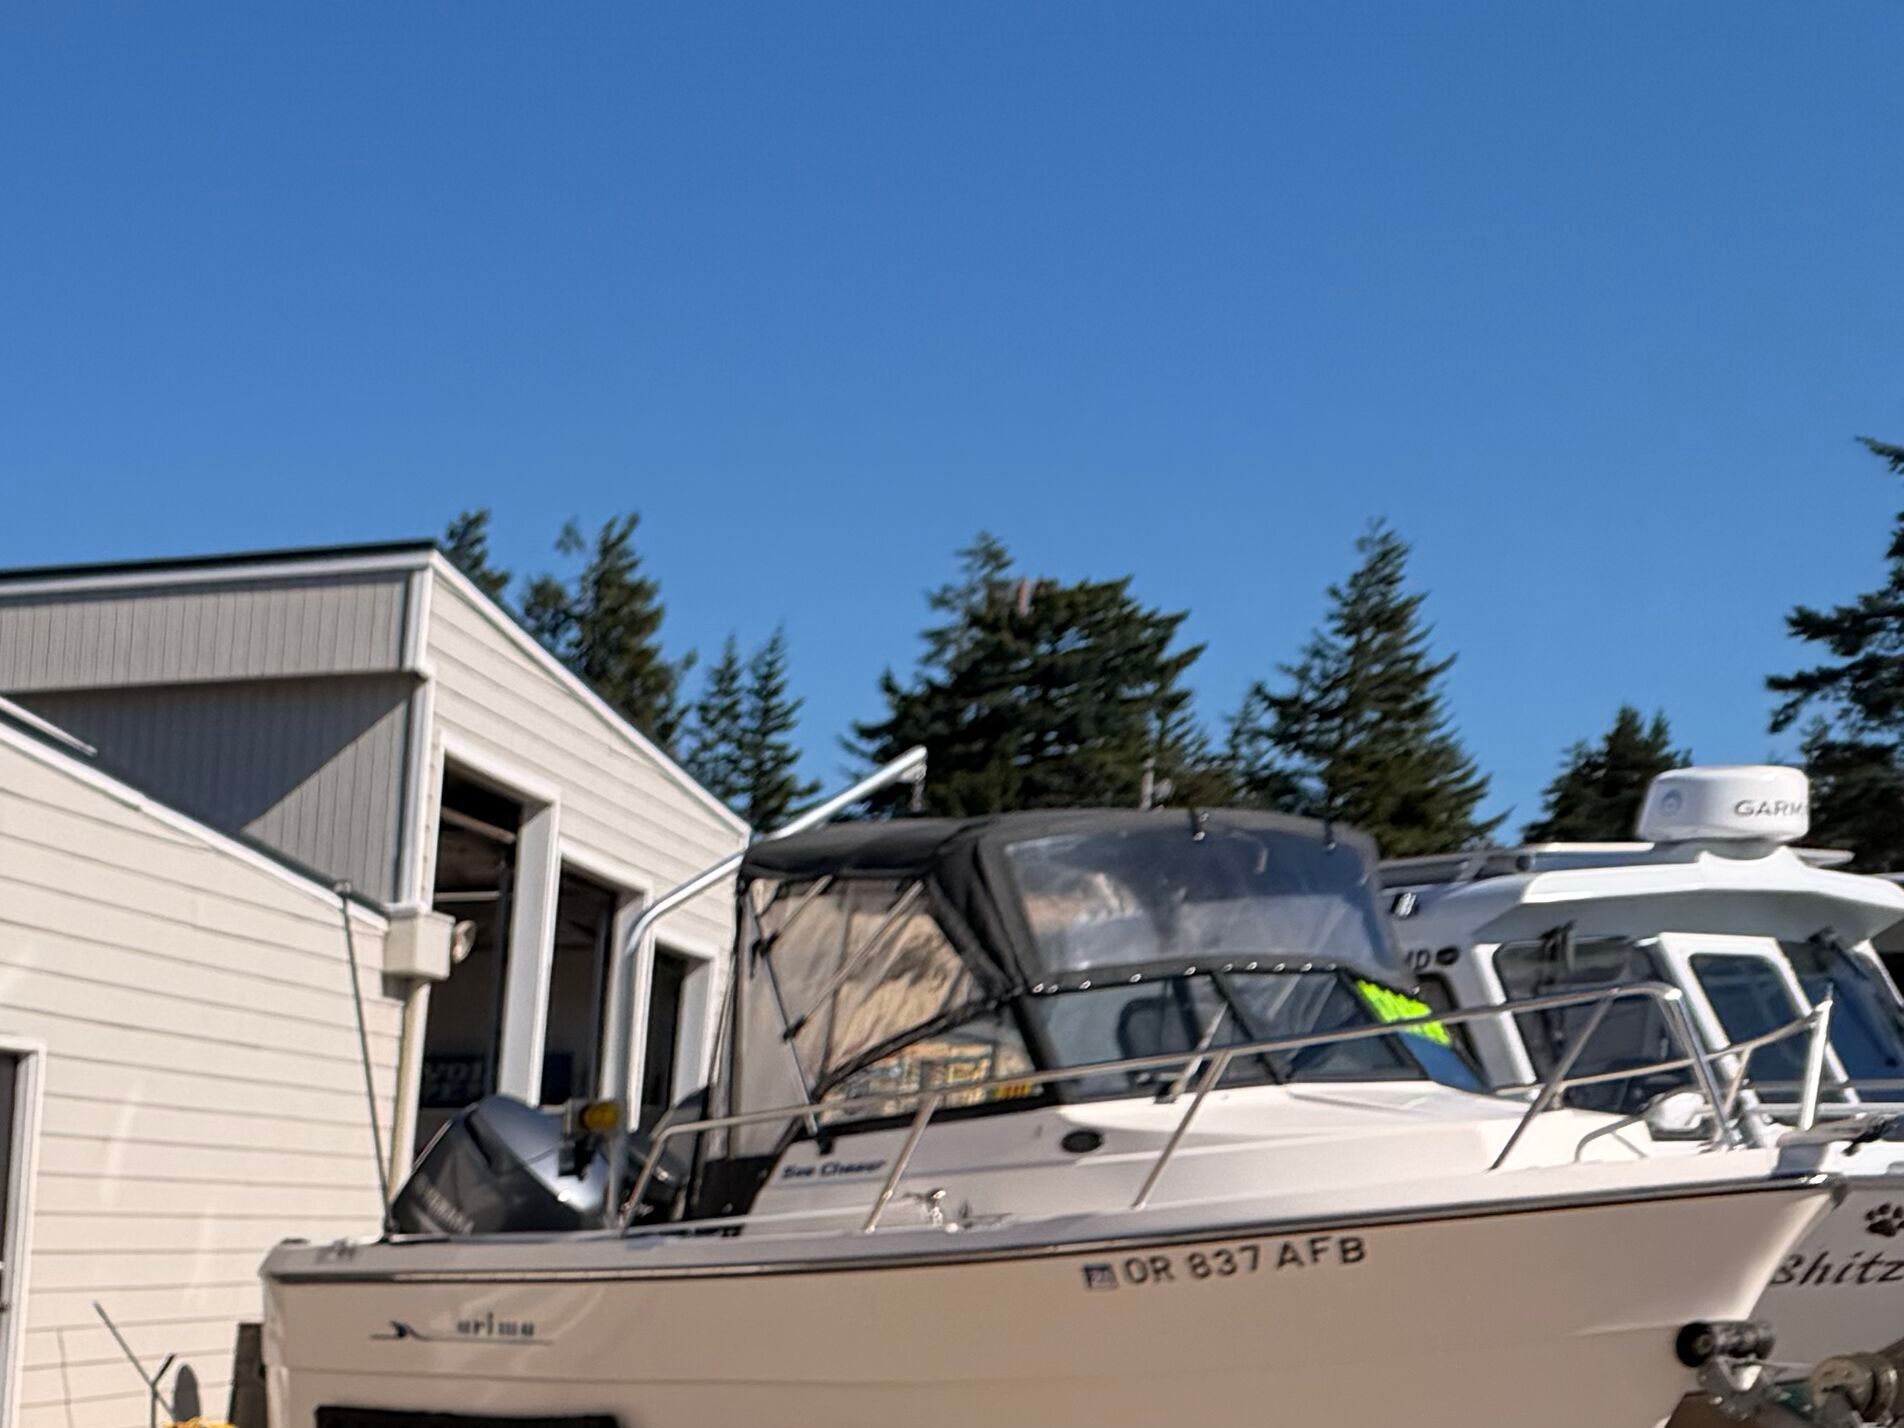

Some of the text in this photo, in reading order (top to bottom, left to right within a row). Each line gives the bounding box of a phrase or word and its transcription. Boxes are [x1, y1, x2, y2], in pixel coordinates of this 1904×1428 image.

[1124, 1256, 1176, 1285] OR
[1187, 1243, 1260, 1280] 837
[1275, 1235, 1367, 1270] AFB
